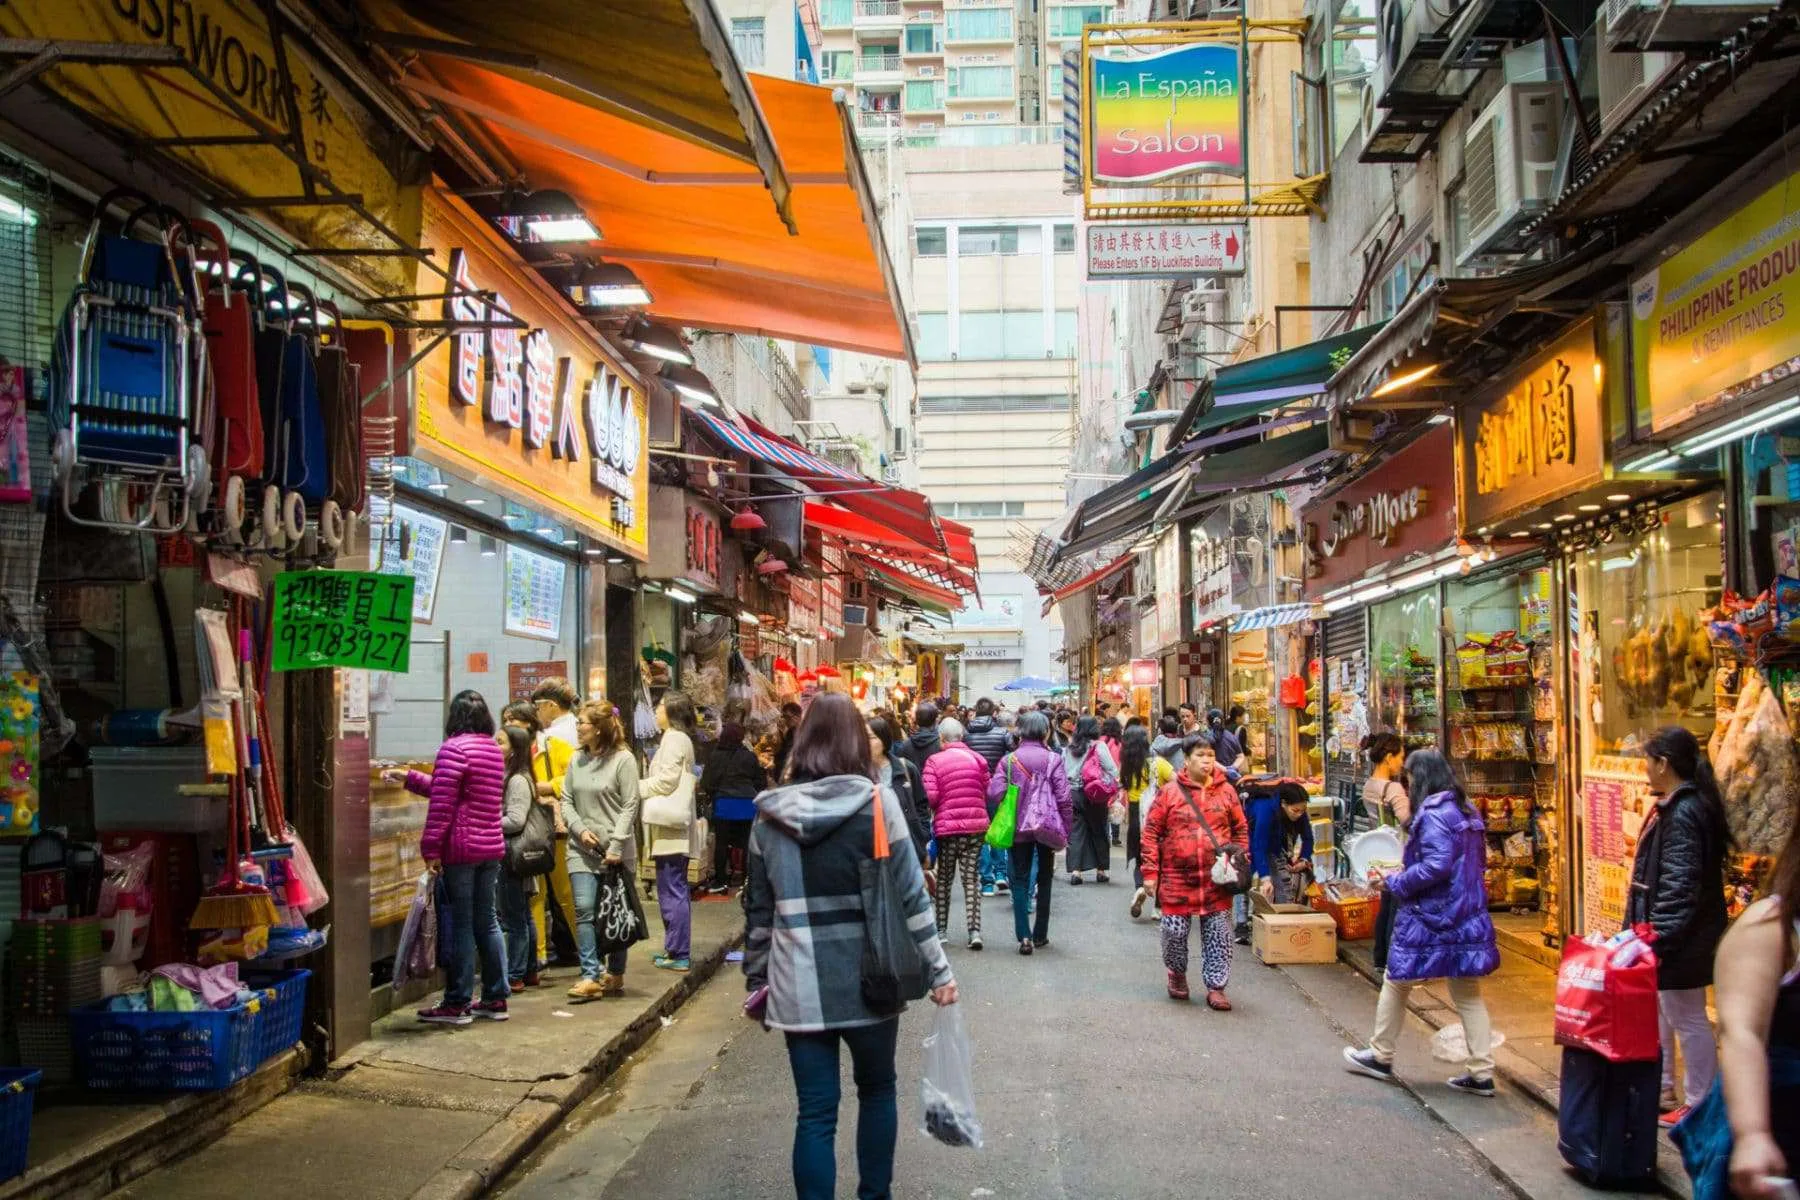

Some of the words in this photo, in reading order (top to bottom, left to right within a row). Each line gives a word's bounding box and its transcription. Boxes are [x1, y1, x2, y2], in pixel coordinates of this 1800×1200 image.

[1100, 73, 1131, 99] La
[1138, 70, 1233, 116] España
[1112, 118, 1223, 154] Salon
[1092, 257, 1115, 269] Please
[1117, 257, 1138, 269] Enters
[1151, 256, 1161, 269] By
[1194, 254, 1223, 270] Building
[1660, 278, 1734, 344] PHILIPPINE
[1738, 239, 1800, 302] PRODU
[1702, 292, 1785, 354] REMITTANCES
[1368, 486, 1421, 548] More
[281, 623, 408, 668] 93783927
[976, 649, 1006, 657] MARKET
